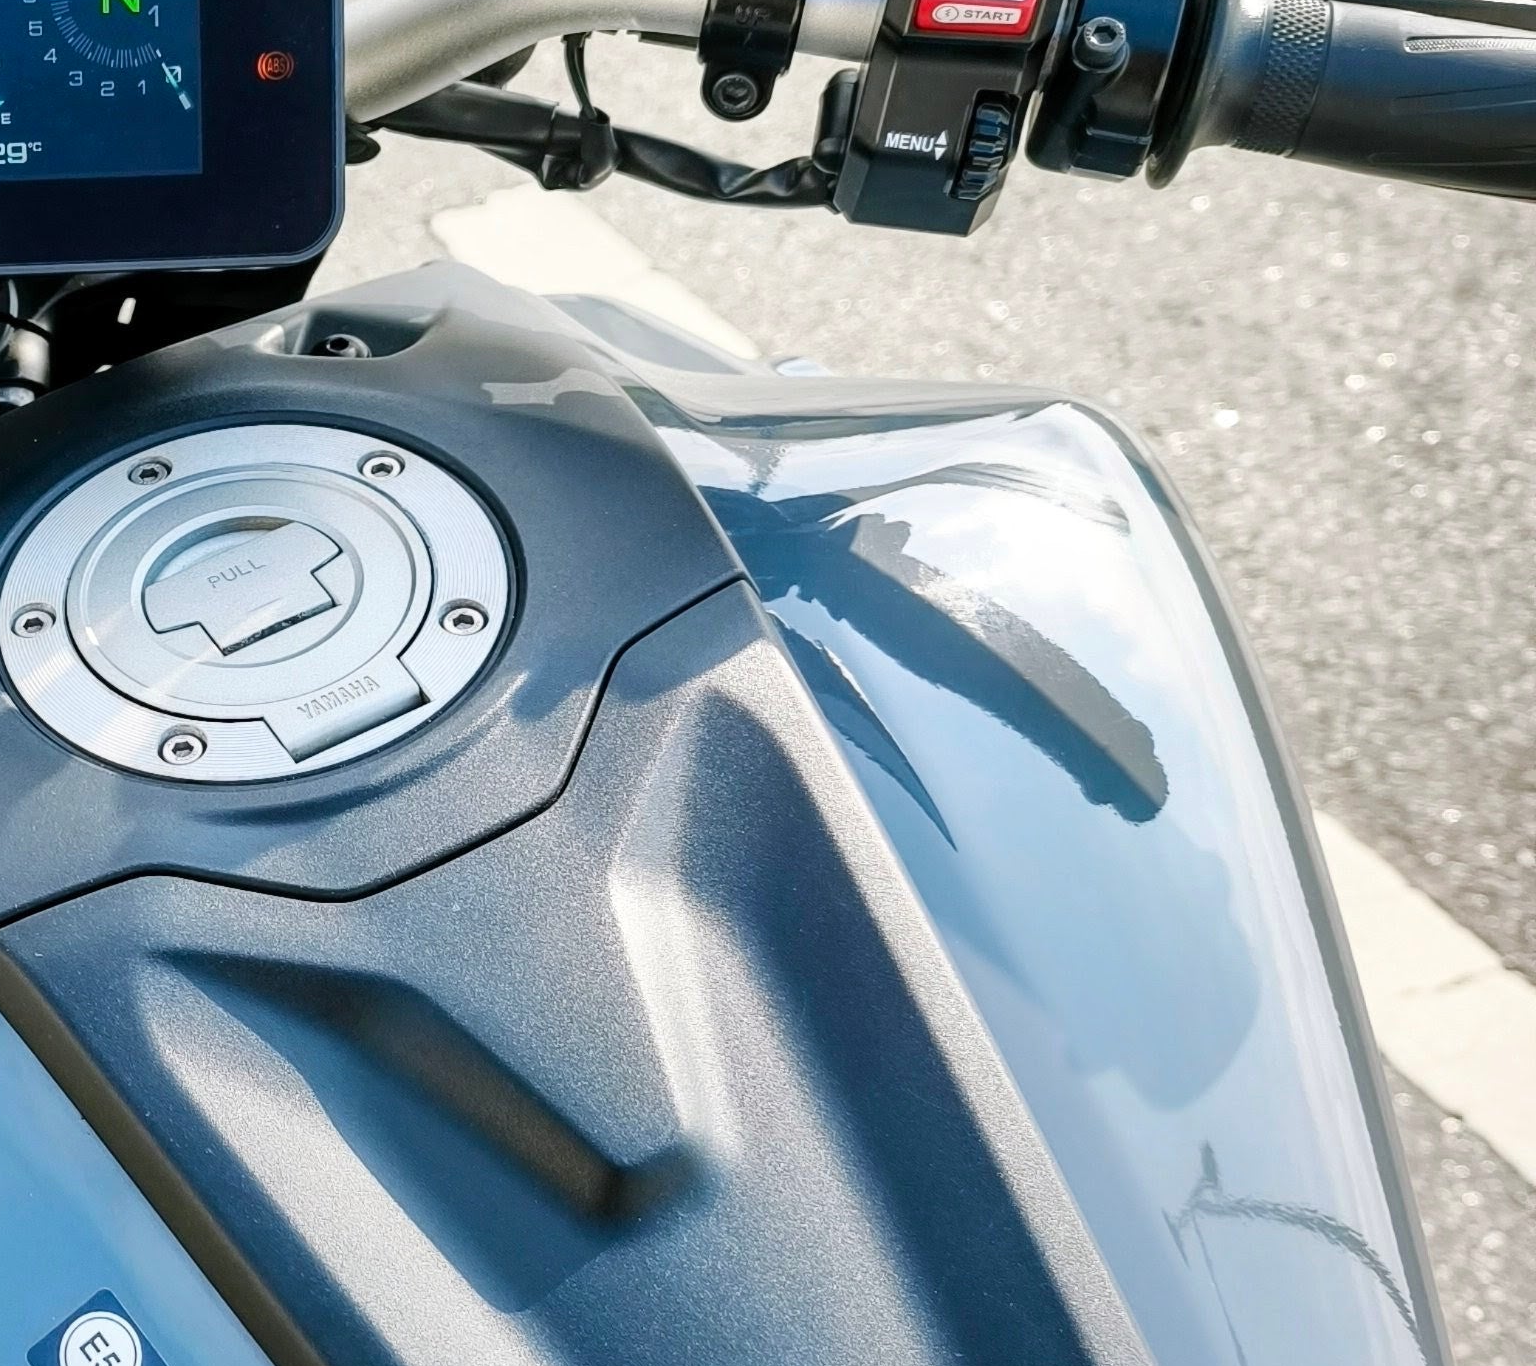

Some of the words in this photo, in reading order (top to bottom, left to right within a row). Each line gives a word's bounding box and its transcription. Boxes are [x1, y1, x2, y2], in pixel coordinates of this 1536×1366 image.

[148, 5, 159, 27] 1
[963, 9, 1014, 23] START
[28, 21, 43, 36] 5
[43, 48, 57, 63] 4
[267, 57, 285, 73] ABS
[69, 71, 83, 86] 3
[100, 81, 115, 97] 2
[138, 80, 146, 95] 1
[0, 112, 11, 125] E
[885, 132, 934, 152] MENU
[207, 557, 266, 588] PULL
[296, 674, 381, 720] YAMAHA
